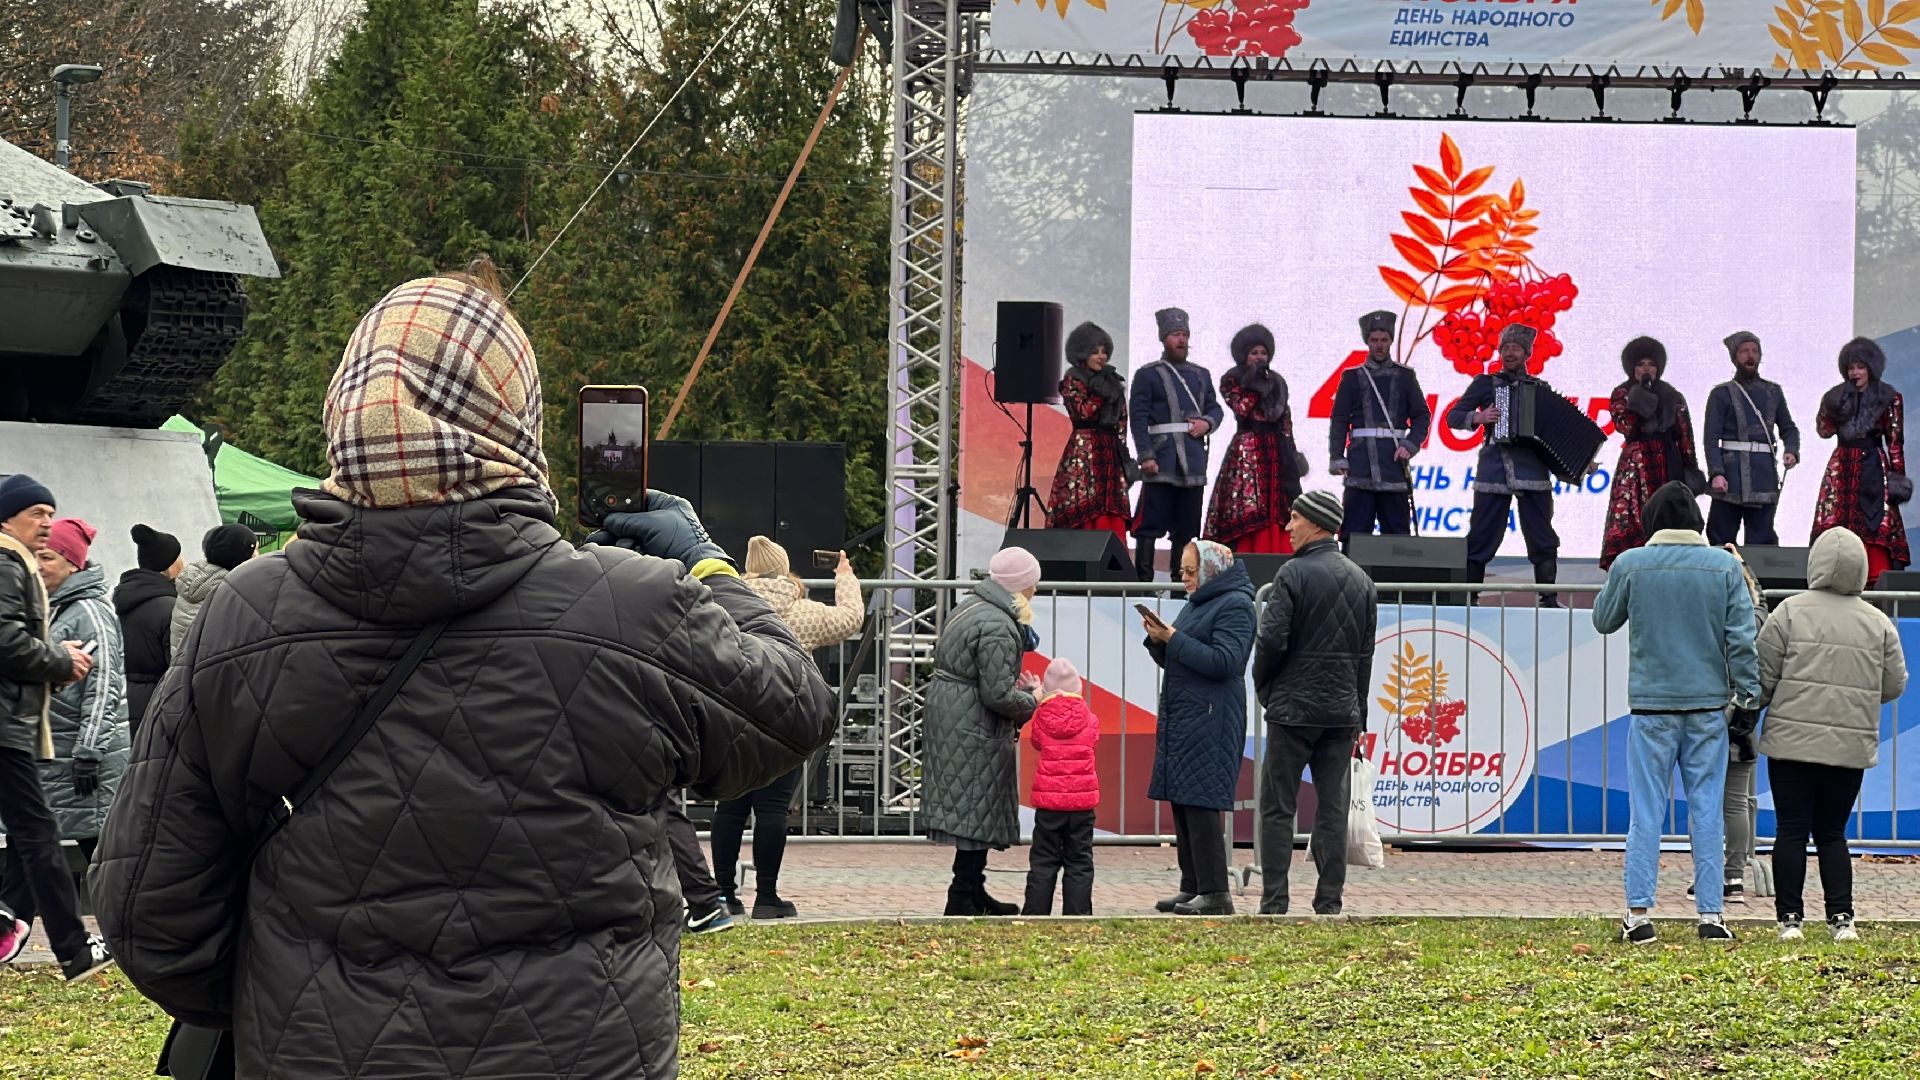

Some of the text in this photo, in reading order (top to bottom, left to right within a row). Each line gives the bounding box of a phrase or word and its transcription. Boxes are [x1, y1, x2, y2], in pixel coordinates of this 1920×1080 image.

[1394, 8, 1575, 27] ДЕНЬ НАРОДНОГО
[1389, 30, 1489, 46] ЕДИНСТВА
[1380, 751, 1506, 776] НОЯБРЯ
[1375, 780, 1500, 793] ДЕНЬ НАРОДНОГО
[1371, 795, 1441, 807] ЕДИНСТВА
